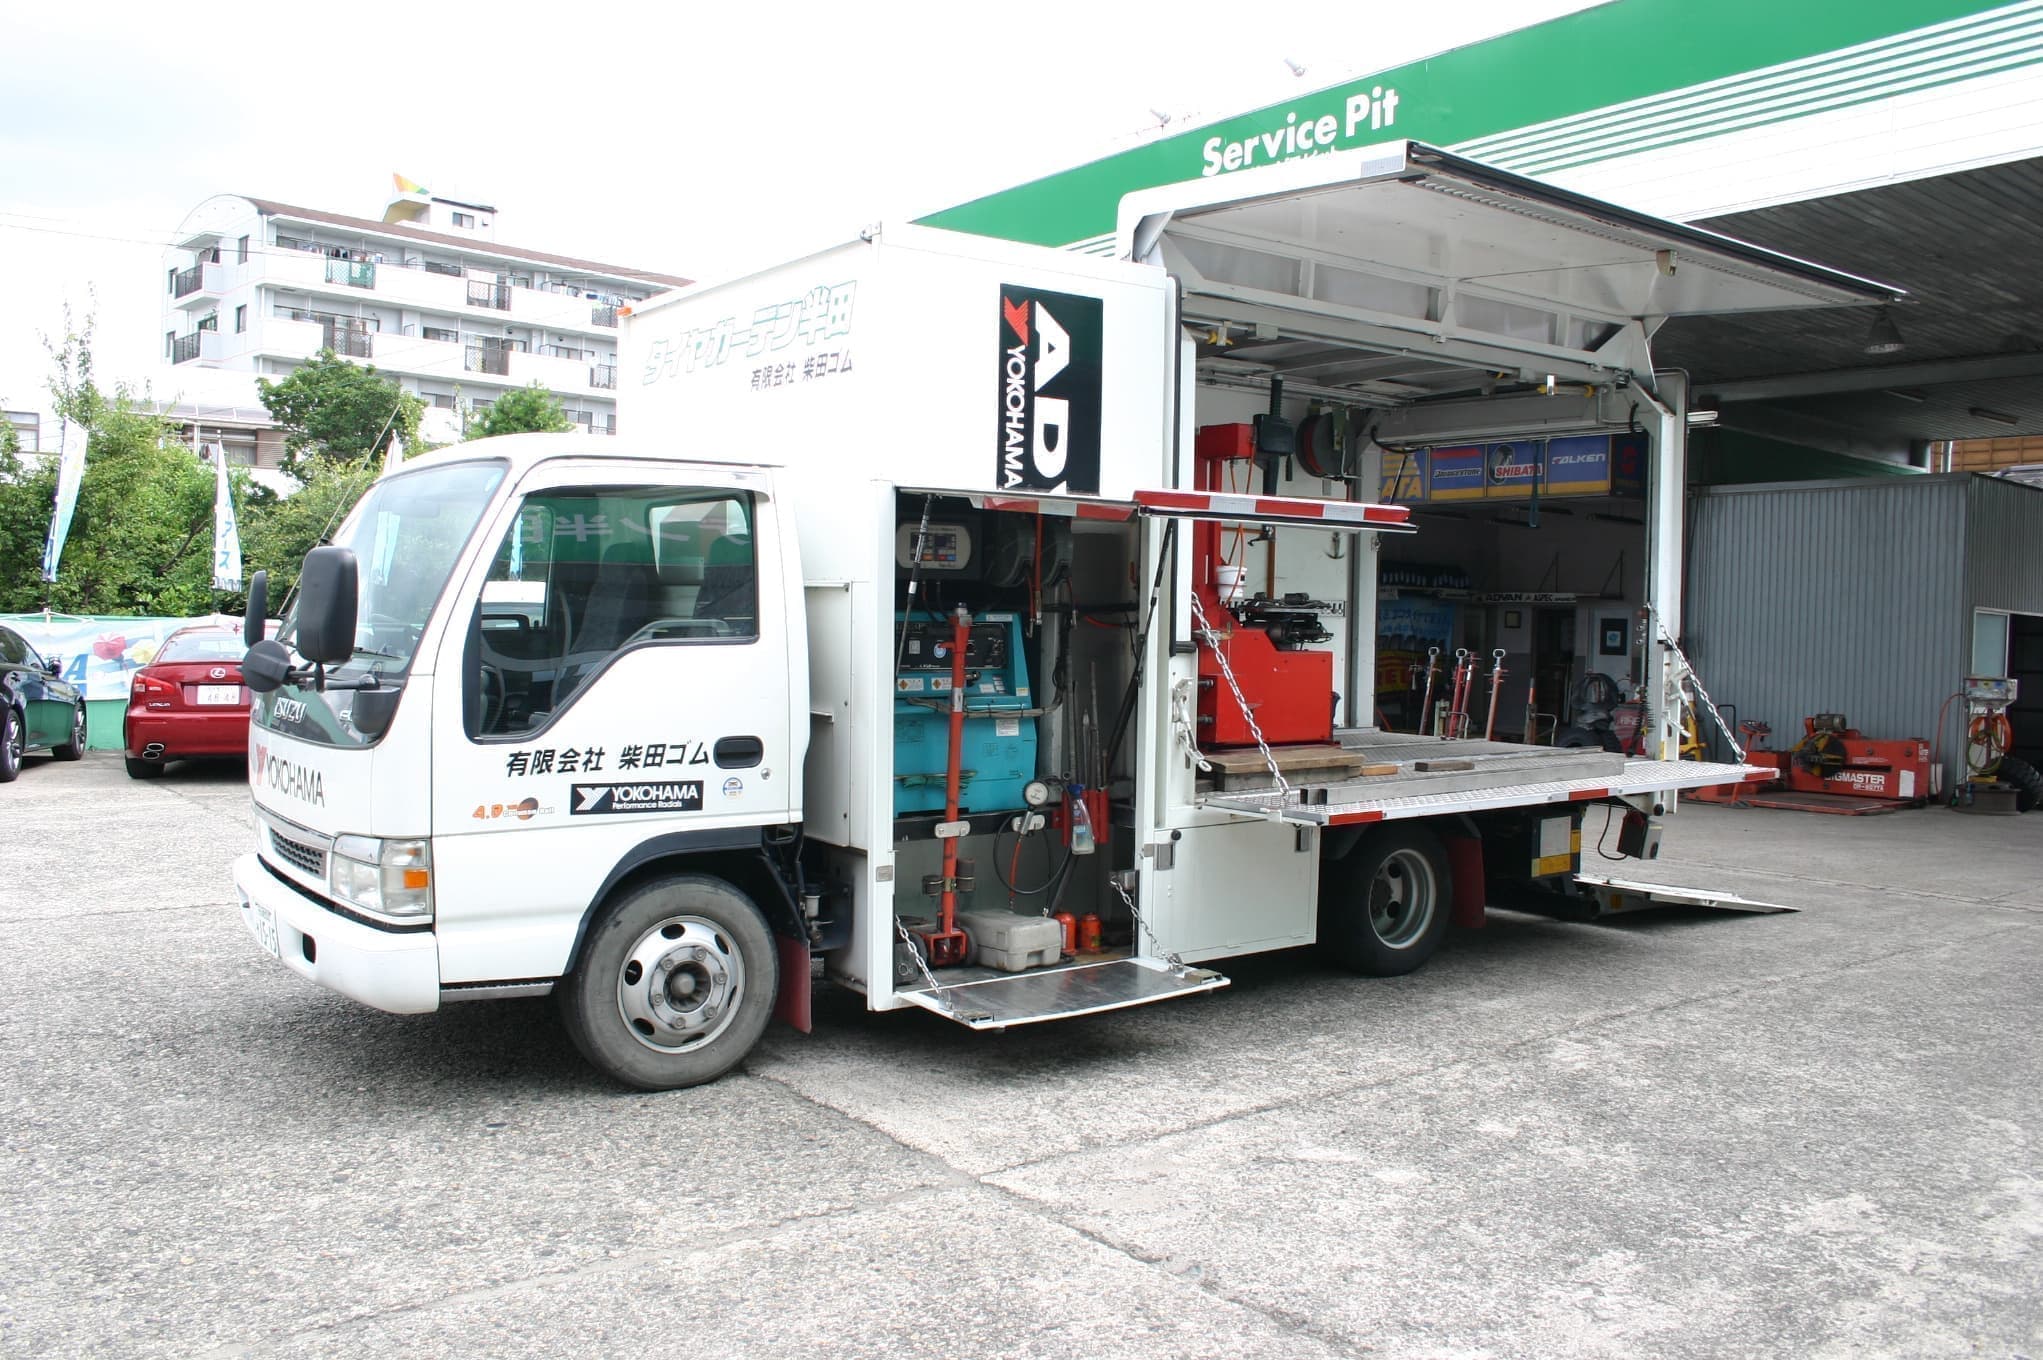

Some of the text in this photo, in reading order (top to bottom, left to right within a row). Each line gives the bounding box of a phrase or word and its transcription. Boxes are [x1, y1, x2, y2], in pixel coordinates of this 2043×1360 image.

[1202, 86, 1399, 177] Service Pit
[642, 280, 857, 386] タイヤガーデン半田
[751, 361, 796, 392] 有限会社
[1033, 300, 1070, 495] AD
[1004, 344, 1026, 489] YOKOHAMA
[266, 753, 325, 808] YOKOHAMA
[506, 740, 709, 778] 有限会社 柴田ゴム
[1824, 772, 1885, 785] GMASTER
[612, 784, 699, 802] YOKOHAMA
[612, 800, 657, 810] Performance
